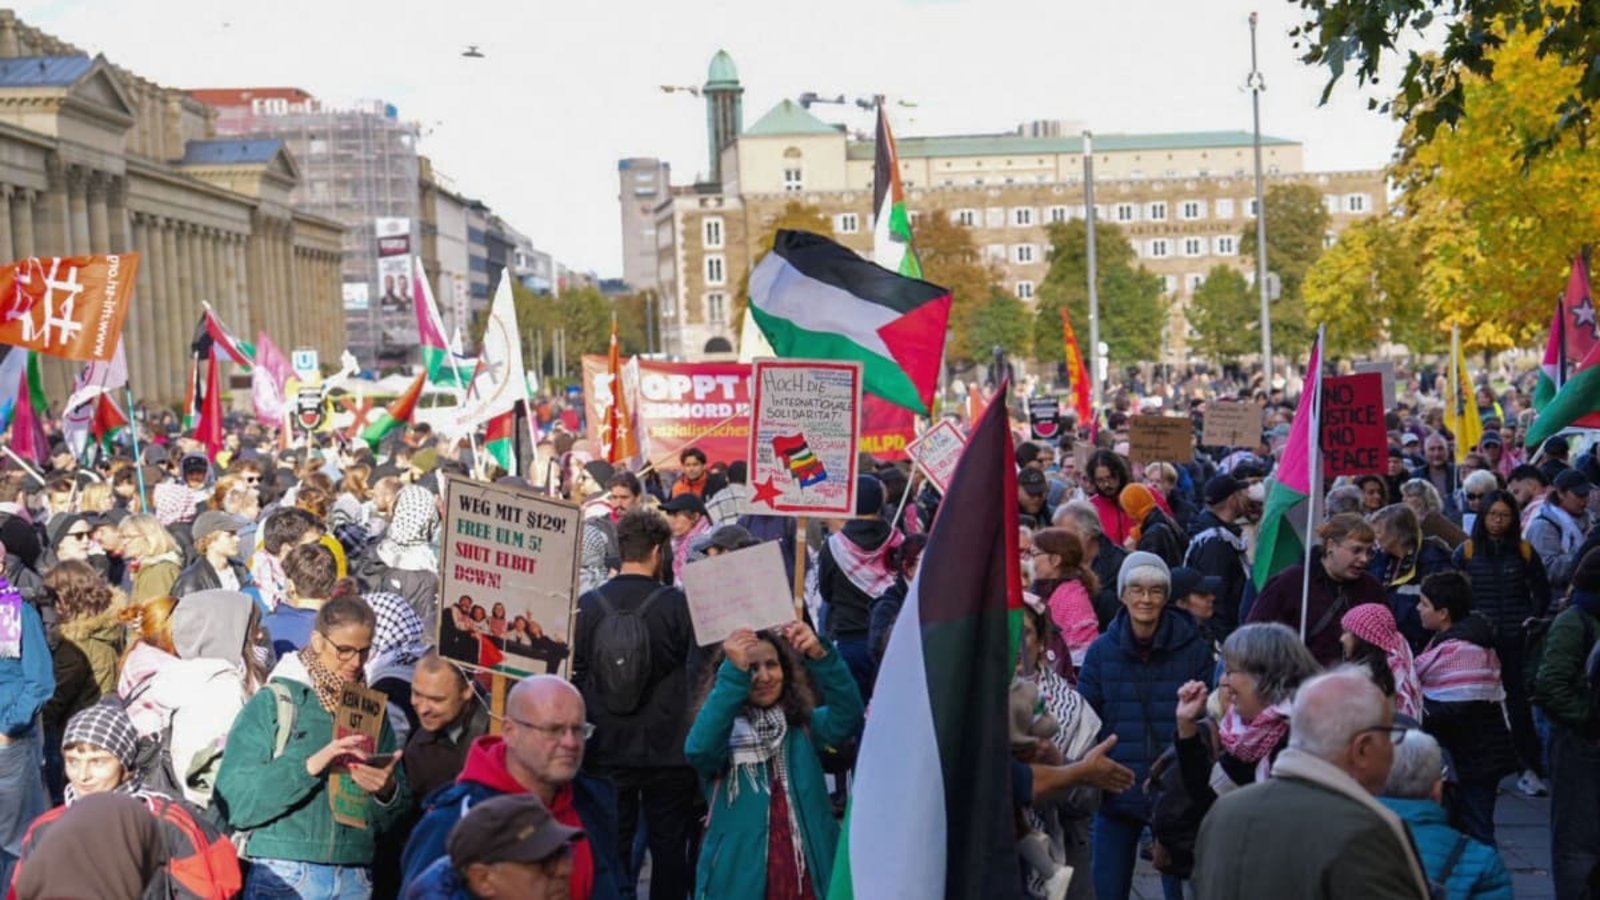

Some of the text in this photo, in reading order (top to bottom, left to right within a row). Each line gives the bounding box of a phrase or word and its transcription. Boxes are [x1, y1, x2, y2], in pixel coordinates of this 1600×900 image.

[763, 370, 804, 392] HOCH
[807, 380, 825, 393] DIE
[1323, 383, 1354, 405] NO
[858, 433, 906, 454] MLPD
[1328, 426, 1355, 447] NO
[459, 494, 567, 534] WEG MIT §129!
[457, 518, 491, 540] FREE
[528, 535, 543, 553] 5!
[455, 541, 537, 574] SHUT ELBIT
[454, 564, 502, 589] DOWN!
[350, 711, 363, 728] IST
